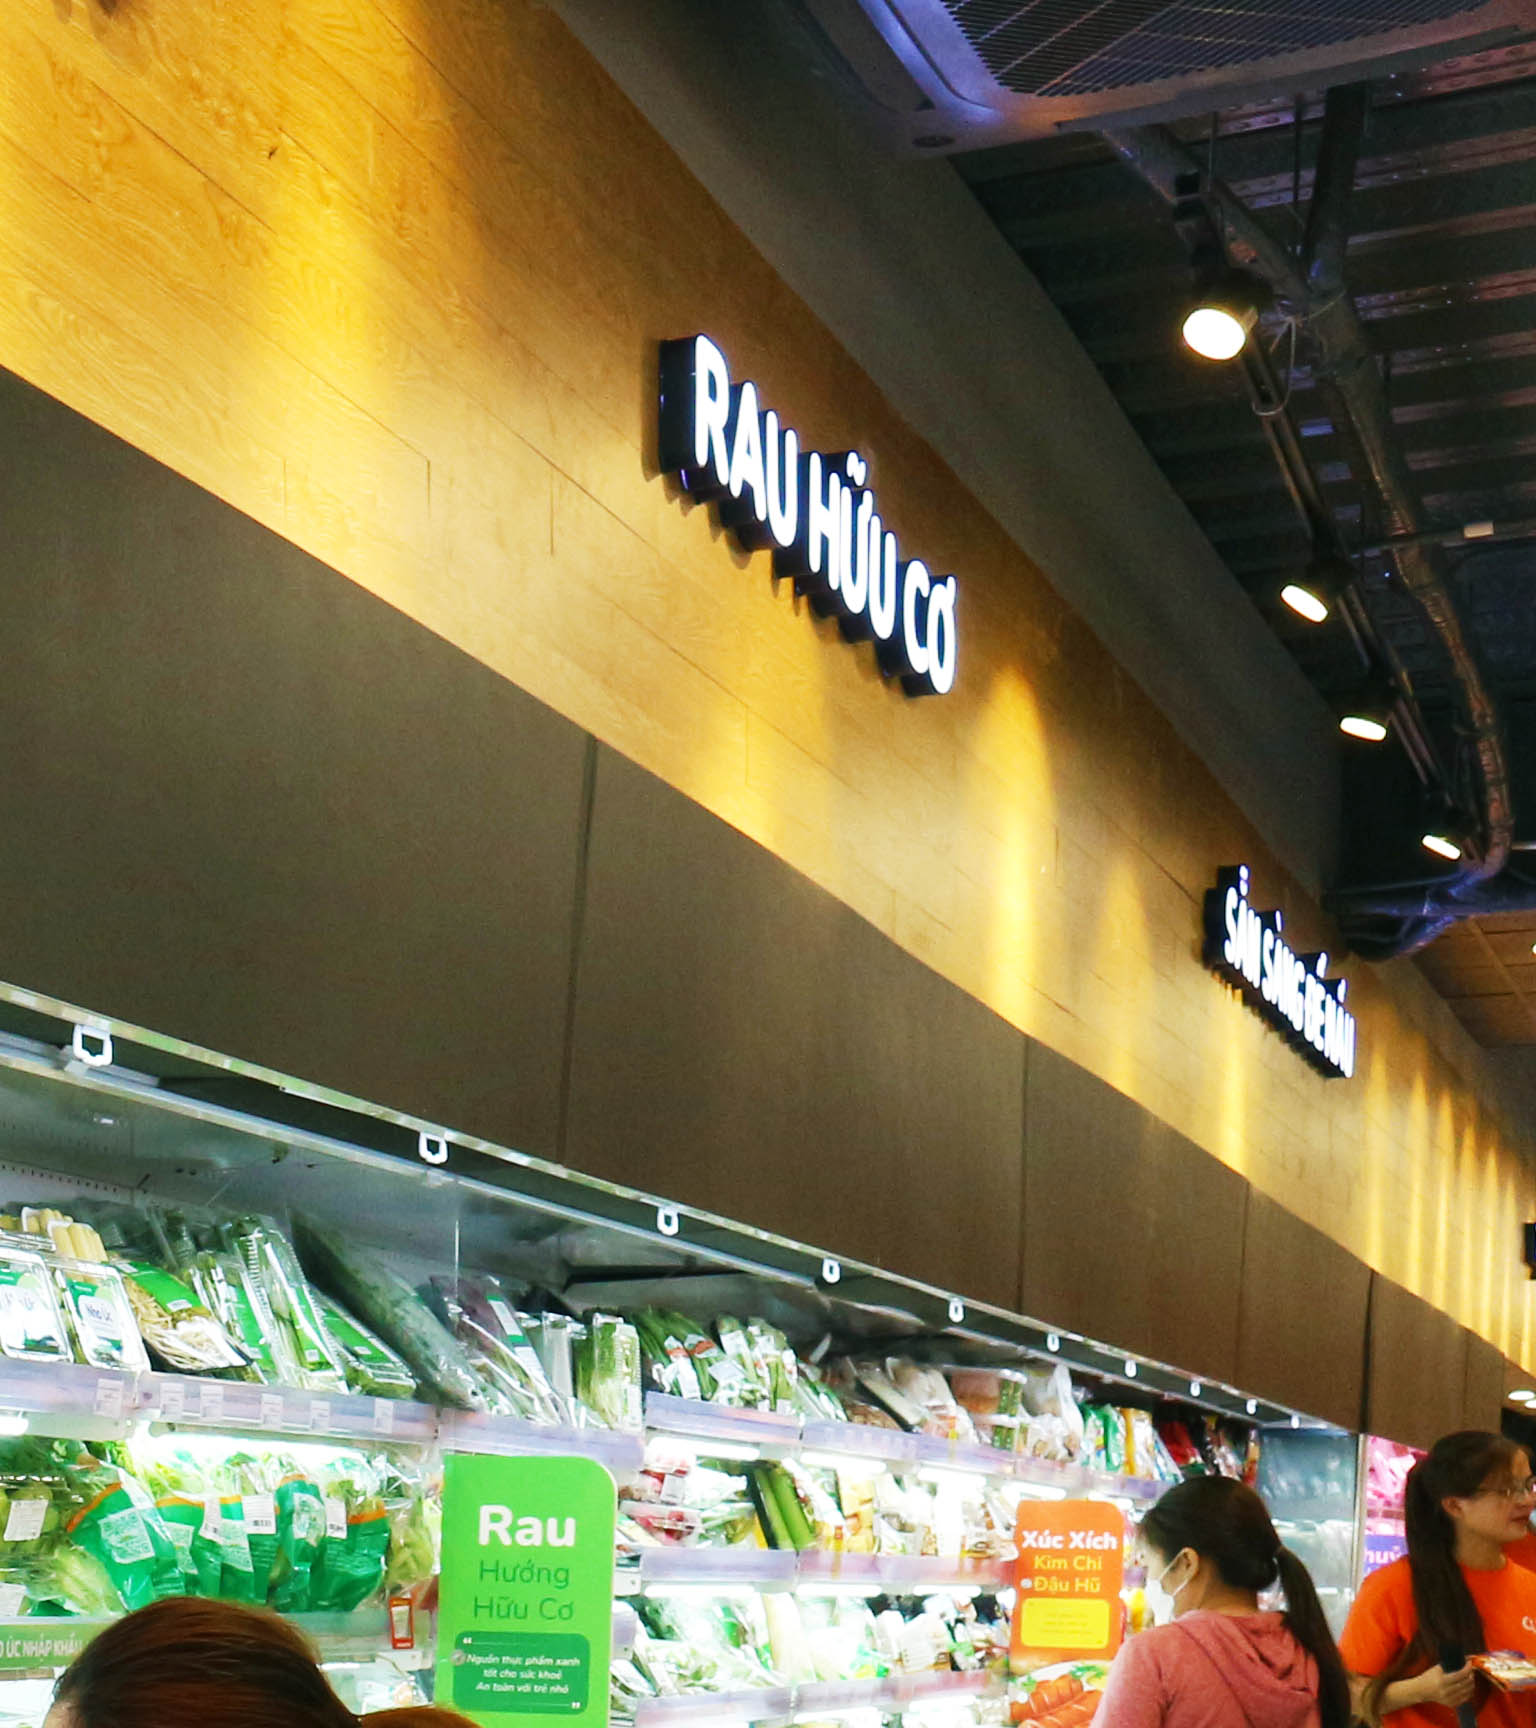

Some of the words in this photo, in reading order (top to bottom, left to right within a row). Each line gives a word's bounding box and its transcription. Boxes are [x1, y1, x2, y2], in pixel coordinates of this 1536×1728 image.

[694, 333, 798, 548] RAU
[808, 450, 898, 639] HỮU
[903, 558, 957, 694] CƠ
[477, 1504, 577, 1548] Rau
[1022, 1529, 1064, 1549] Xúc
[1069, 1530, 1118, 1550] Xích
[1034, 1555, 1068, 1570] Kim
[1073, 1555, 1102, 1571] Chi
[479, 1558, 570, 1590] Hướng
[1034, 1576, 1069, 1594] Đậu
[1075, 1577, 1101, 1593] Hũ
[473, 1595, 528, 1622] Hữu
[539, 1595, 574, 1622] Cơ
[555, 1657, 580, 1666] xanh
[499, 1670, 517, 1678] cho
